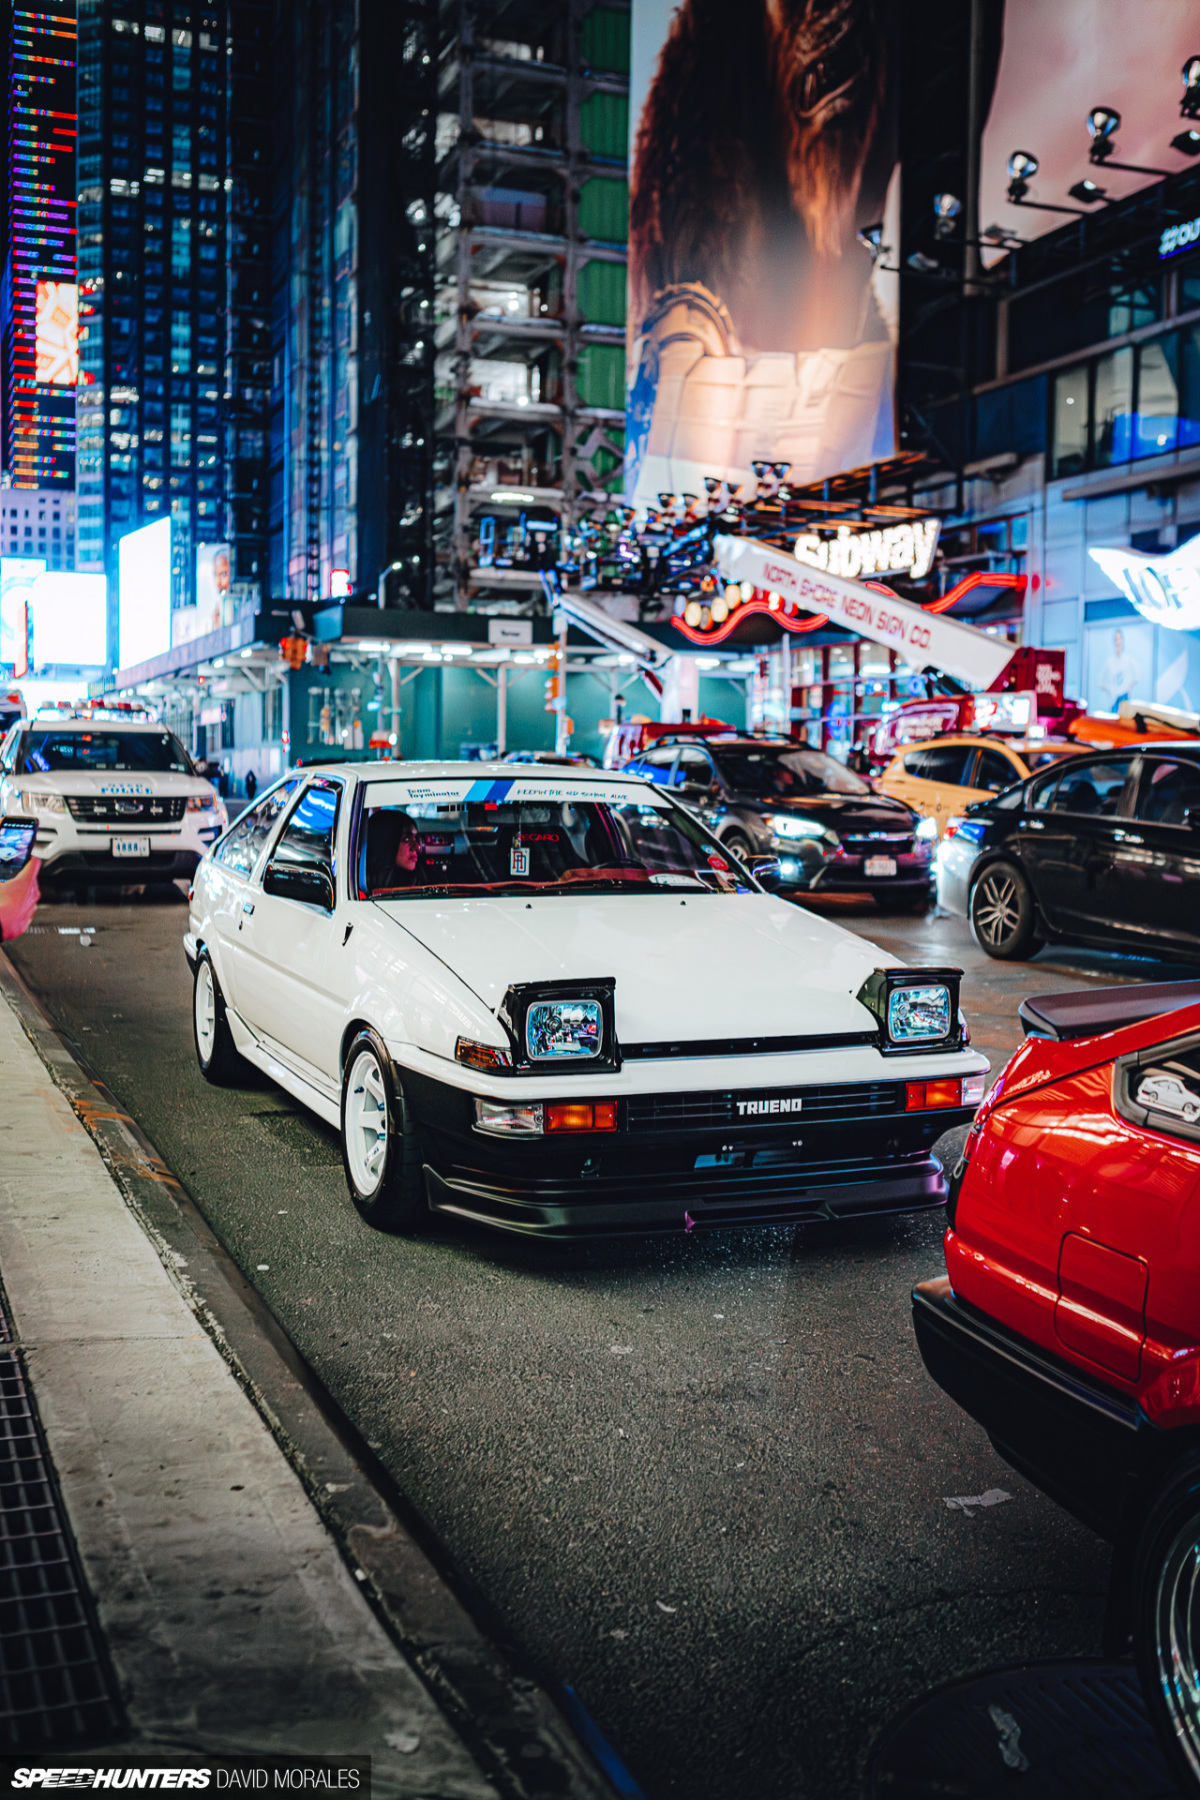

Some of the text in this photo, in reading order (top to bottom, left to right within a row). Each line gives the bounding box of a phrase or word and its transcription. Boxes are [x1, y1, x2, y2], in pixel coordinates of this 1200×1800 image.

[762, 561, 799, 592] NORTH
[800, 577, 840, 608] SHORE
[841, 595, 877, 626] NEON
[876, 610, 909, 641] SIGN
[101, 786, 153, 795] POLICE
[736, 1098, 803, 1116] TRUENO
